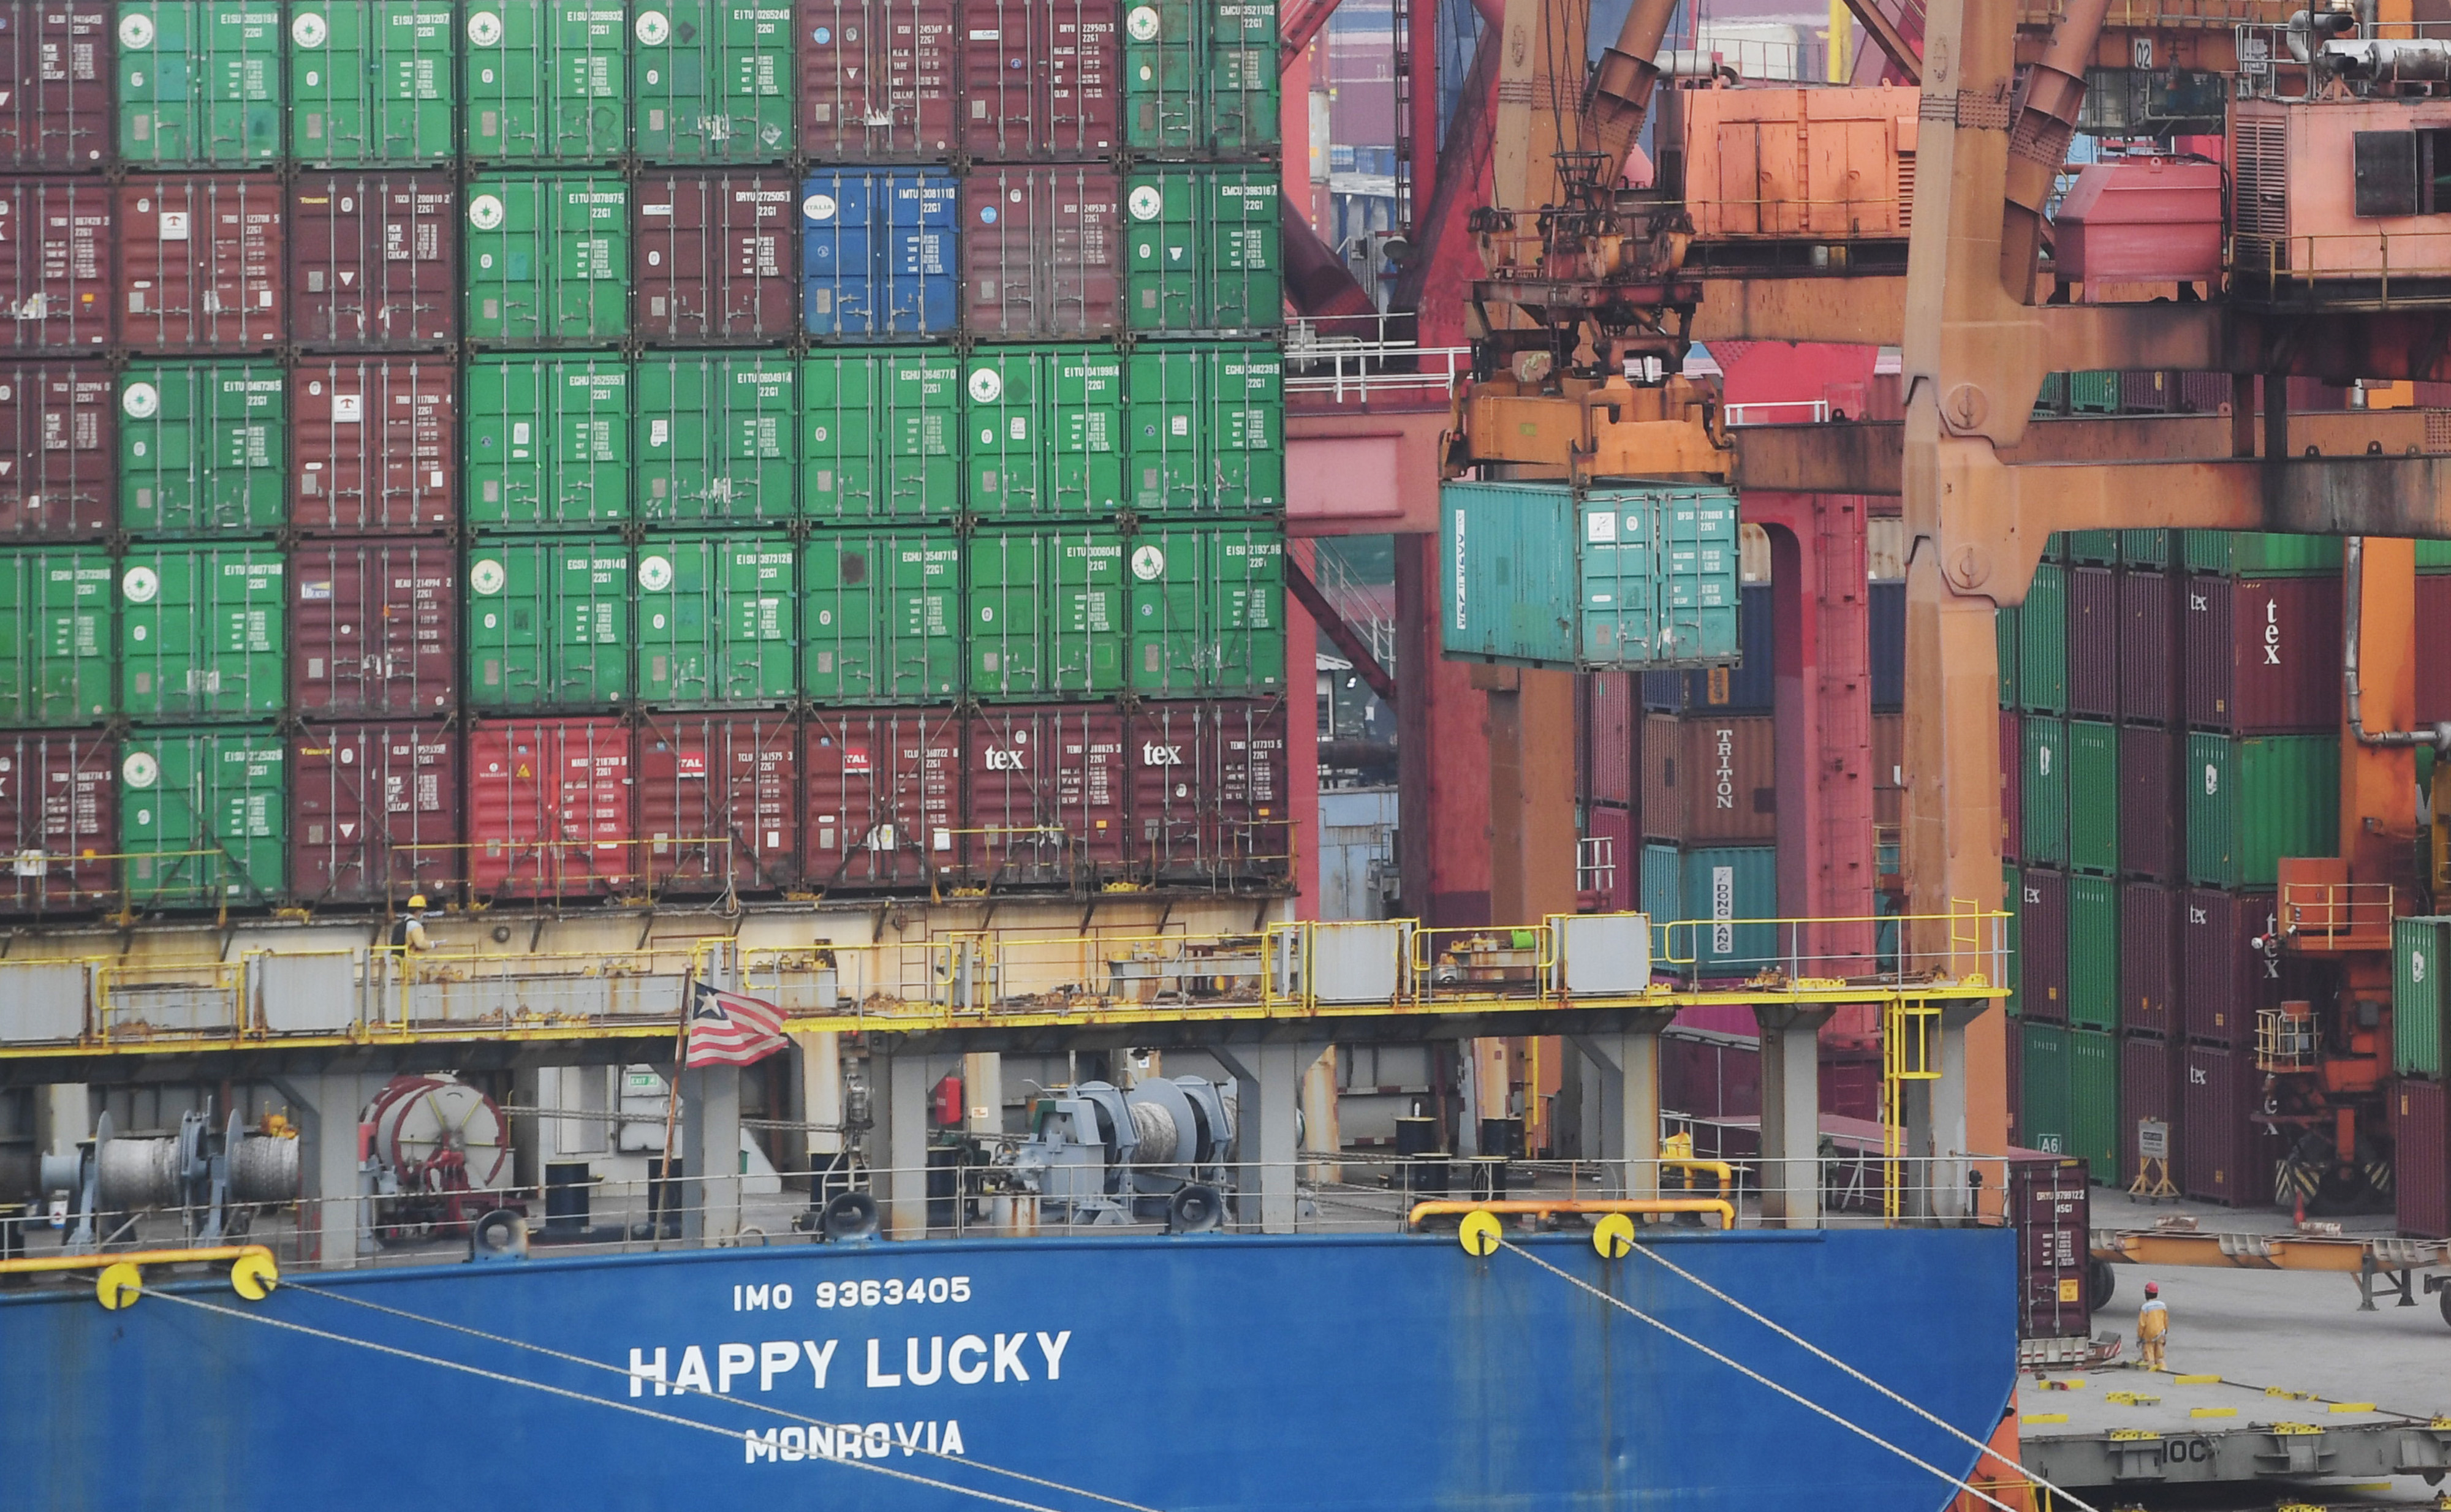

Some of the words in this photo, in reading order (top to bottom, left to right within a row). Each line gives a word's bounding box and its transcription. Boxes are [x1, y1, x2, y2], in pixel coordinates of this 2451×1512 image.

[734, 10, 754, 20] EITU
[757, 9, 790, 19] 0265240
[1220, 6, 1241, 15] EMCU
[1243, 5, 1275, 15] 3521102
[221, 14, 241, 24] EISU
[393, 15, 413, 25] EISU
[417, 13, 450, 25] 2081207
[567, 12, 587, 21] EISU
[1244, 18, 1262, 28] 22G1
[245, 28, 262, 37] 22G1
[417, 27, 434, 37] 22G1
[591, 25, 609, 34] 22G1
[757, 24, 774, 33] 22G1
[920, 35, 934, 44] 22G1
[1083, 34, 1099, 43] 22G1
[2136, 42, 2150, 67] 02
[898, 189, 919, 199] IMTU
[923, 187, 955, 198] 3081110
[1222, 186, 1243, 195] EMCU
[569, 194, 589, 203] EITU
[735, 191, 756, 202] DRYU
[758, 191, 790, 202] 2725051
[417, 205, 434, 213] 22G1
[923, 203, 941, 213] 22G1
[1246, 200, 1263, 210] 22G1
[593, 208, 611, 218] 22G1
[759, 206, 776, 216] 22G1
[1084, 214, 1099, 223] 22G1
[1064, 368, 1084, 377] EITU
[1087, 366, 1119, 376] 0419984
[592, 375, 625, 385] 3525551
[737, 373, 757, 383] EITU
[759, 372, 792, 382] 0604914
[224, 381, 244, 391] EITU
[1088, 380, 1105, 390] 22G1
[1248, 378, 1265, 388] 22G1
[760, 387, 778, 396] 22G1
[924, 384, 941, 393] 22G1
[593, 390, 610, 399] 22G1
[248, 396, 267, 406] 22G1
[417, 406, 432, 415] 22G1
[1700, 522, 1716, 532] 22G1
[1067, 547, 1086, 557] EITU
[1226, 545, 1246, 556] EISU
[737, 554, 756, 564] EISU
[759, 553, 792, 564] 3973126
[593, 559, 626, 569] 3079140
[1089, 561, 1107, 571] 22G1
[224, 564, 245, 575] EITU
[760, 568, 776, 578] 22G1
[925, 565, 943, 575] 22G1
[594, 572, 611, 583] 22G1
[248, 578, 267, 589] 22G1
[417, 589, 432, 599] 22G1
[2263, 598, 2280, 664] tex
[738, 753, 753, 762] TCLU
[760, 752, 783, 762] 361575
[904, 750, 919, 759] TCLU
[985, 744, 1024, 770] tex
[1143, 740, 1181, 766] tex
[1252, 750, 1267, 760] 22G1
[679, 758, 703, 768] TAL
[845, 755, 868, 763] TAL
[926, 759, 940, 768] 22G1
[1090, 754, 1106, 764] 22G1
[249, 765, 267, 776] 22G1
[596, 767, 611, 777] 22G1
[760, 762, 775, 772] 22G1
[1717, 730, 1733, 808] TRITON
[1717, 884, 1729, 916] DONG
[1717, 920, 1729, 951] ANG
[2041, 1138, 2058, 1152] A6
[2037, 1190, 2054, 1201] DRYU
[2056, 1203, 2073, 1213] 45G1
[733, 1283, 792, 1312] IMO
[816, 1276, 971, 1309] 9363405
[629, 1339, 838, 1397] HAPPY
[866, 1330, 1072, 1388] LUCKY
[745, 1420, 965, 1464] MONROVIA
